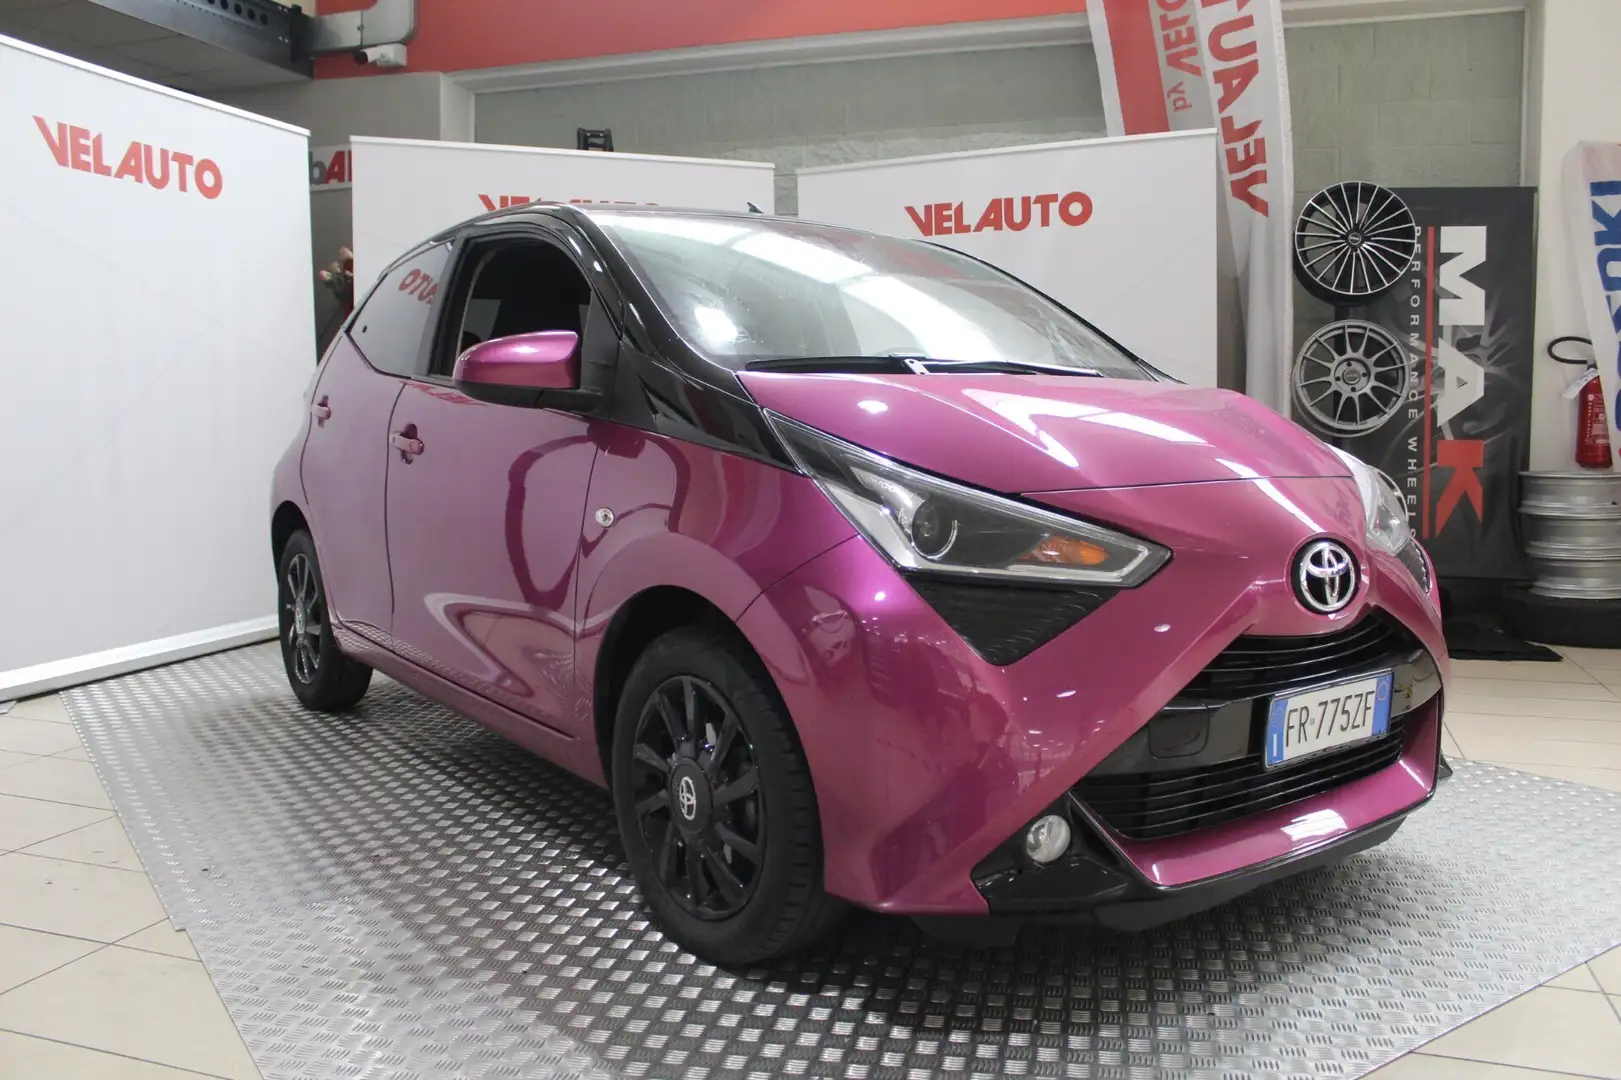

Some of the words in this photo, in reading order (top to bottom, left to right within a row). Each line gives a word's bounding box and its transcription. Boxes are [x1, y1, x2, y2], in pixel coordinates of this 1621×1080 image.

[32, 115, 223, 200] VELAUTO
[903, 191, 1093, 237] VELAUTO
[1407, 225, 1422, 419] PERFORMANCE
[1435, 225, 1487, 538] MAK
